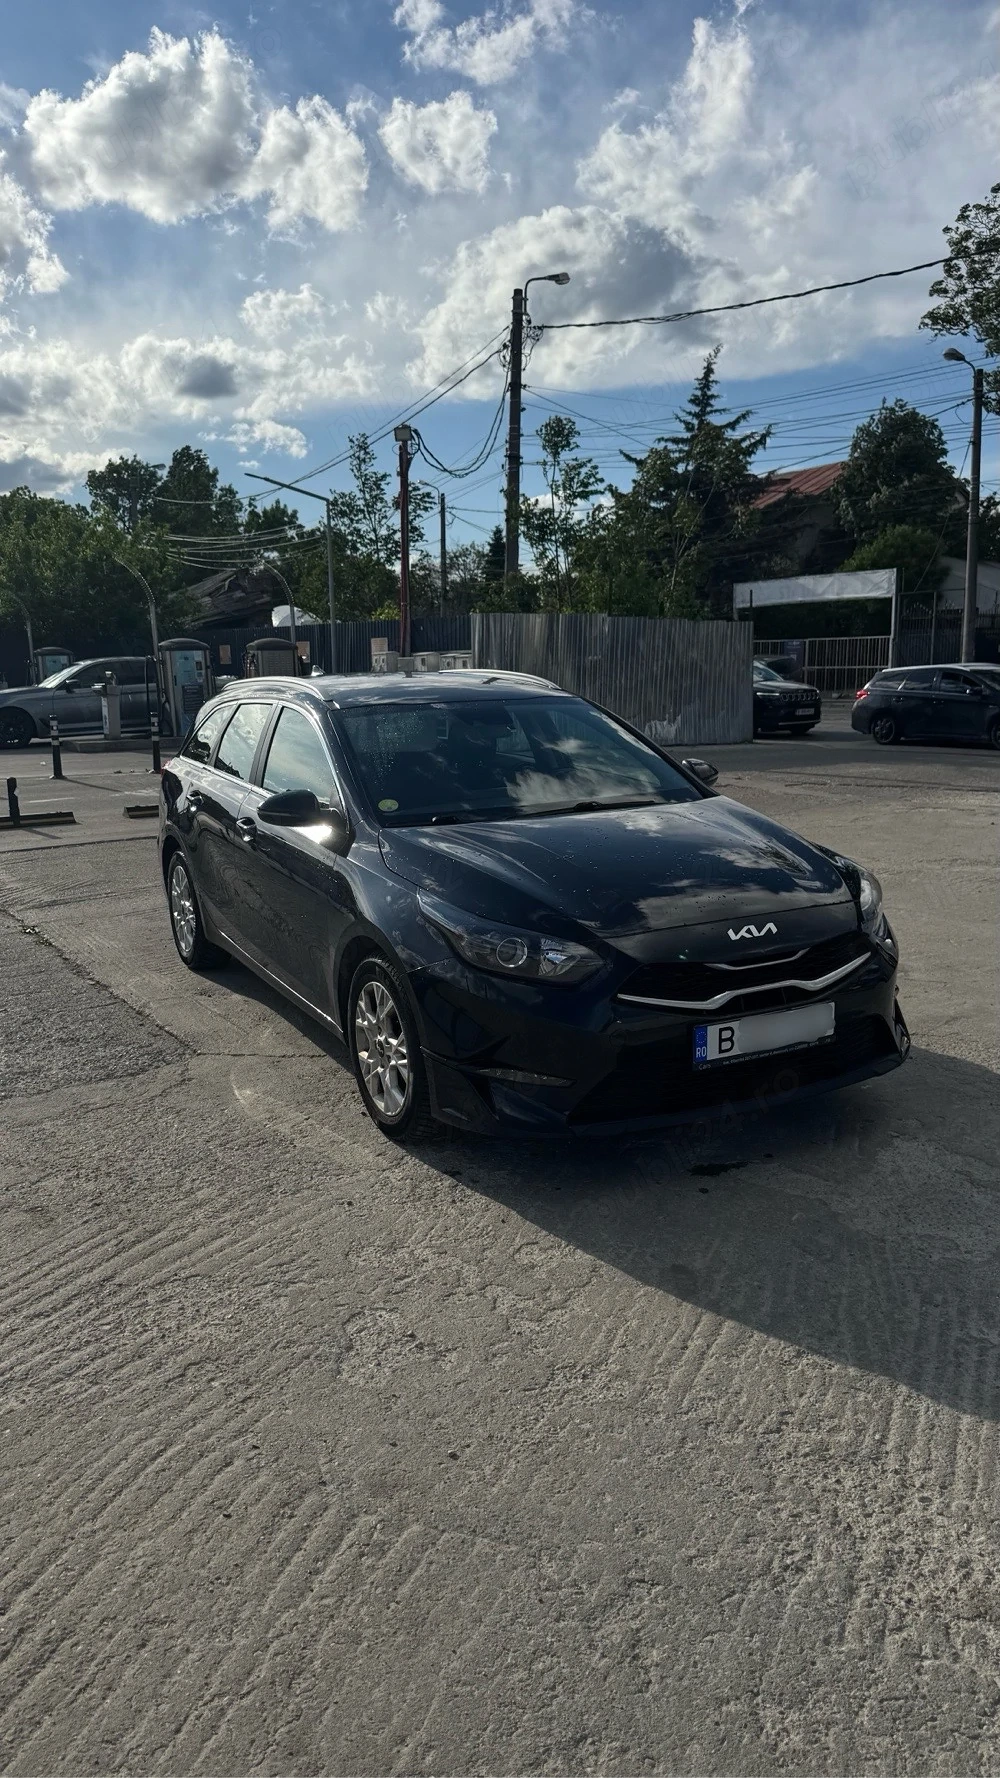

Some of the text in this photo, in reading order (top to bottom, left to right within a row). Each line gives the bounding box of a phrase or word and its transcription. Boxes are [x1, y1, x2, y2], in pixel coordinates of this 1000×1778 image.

[727, 922, 777, 941] KIA
[718, 1026, 735, 1055] B
[695, 1046, 707, 1059] RO
